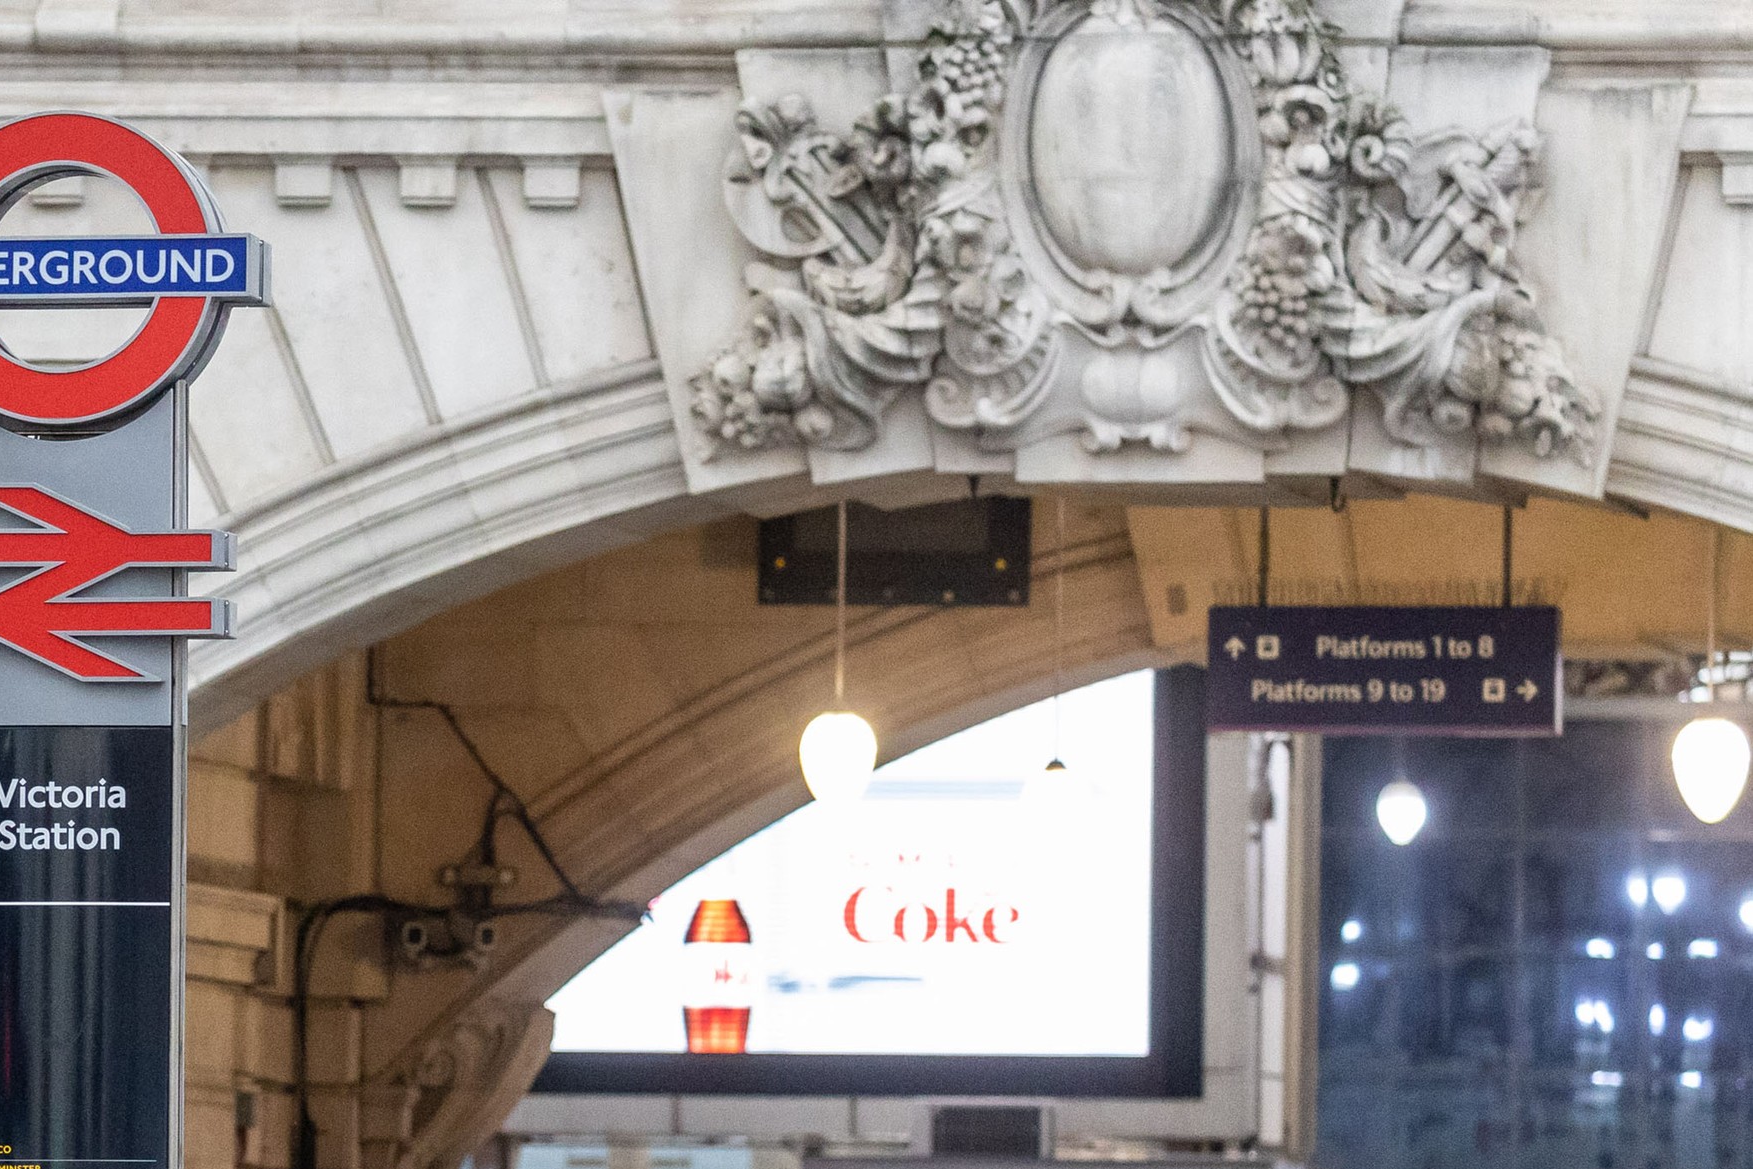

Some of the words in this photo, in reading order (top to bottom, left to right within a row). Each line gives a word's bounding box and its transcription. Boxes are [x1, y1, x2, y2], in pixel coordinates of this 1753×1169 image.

[1316, 634, 1426, 659] Platforms
[1432, 634, 1442, 659] 1
[1448, 637, 1472, 659] to
[1478, 634, 1494, 659] 8
[1251, 677, 1362, 702] Platforms
[1366, 678, 1384, 702] 9
[1389, 681, 1414, 703] to
[1420, 678, 1446, 703] 19
[843, 887, 1019, 943] Coke
